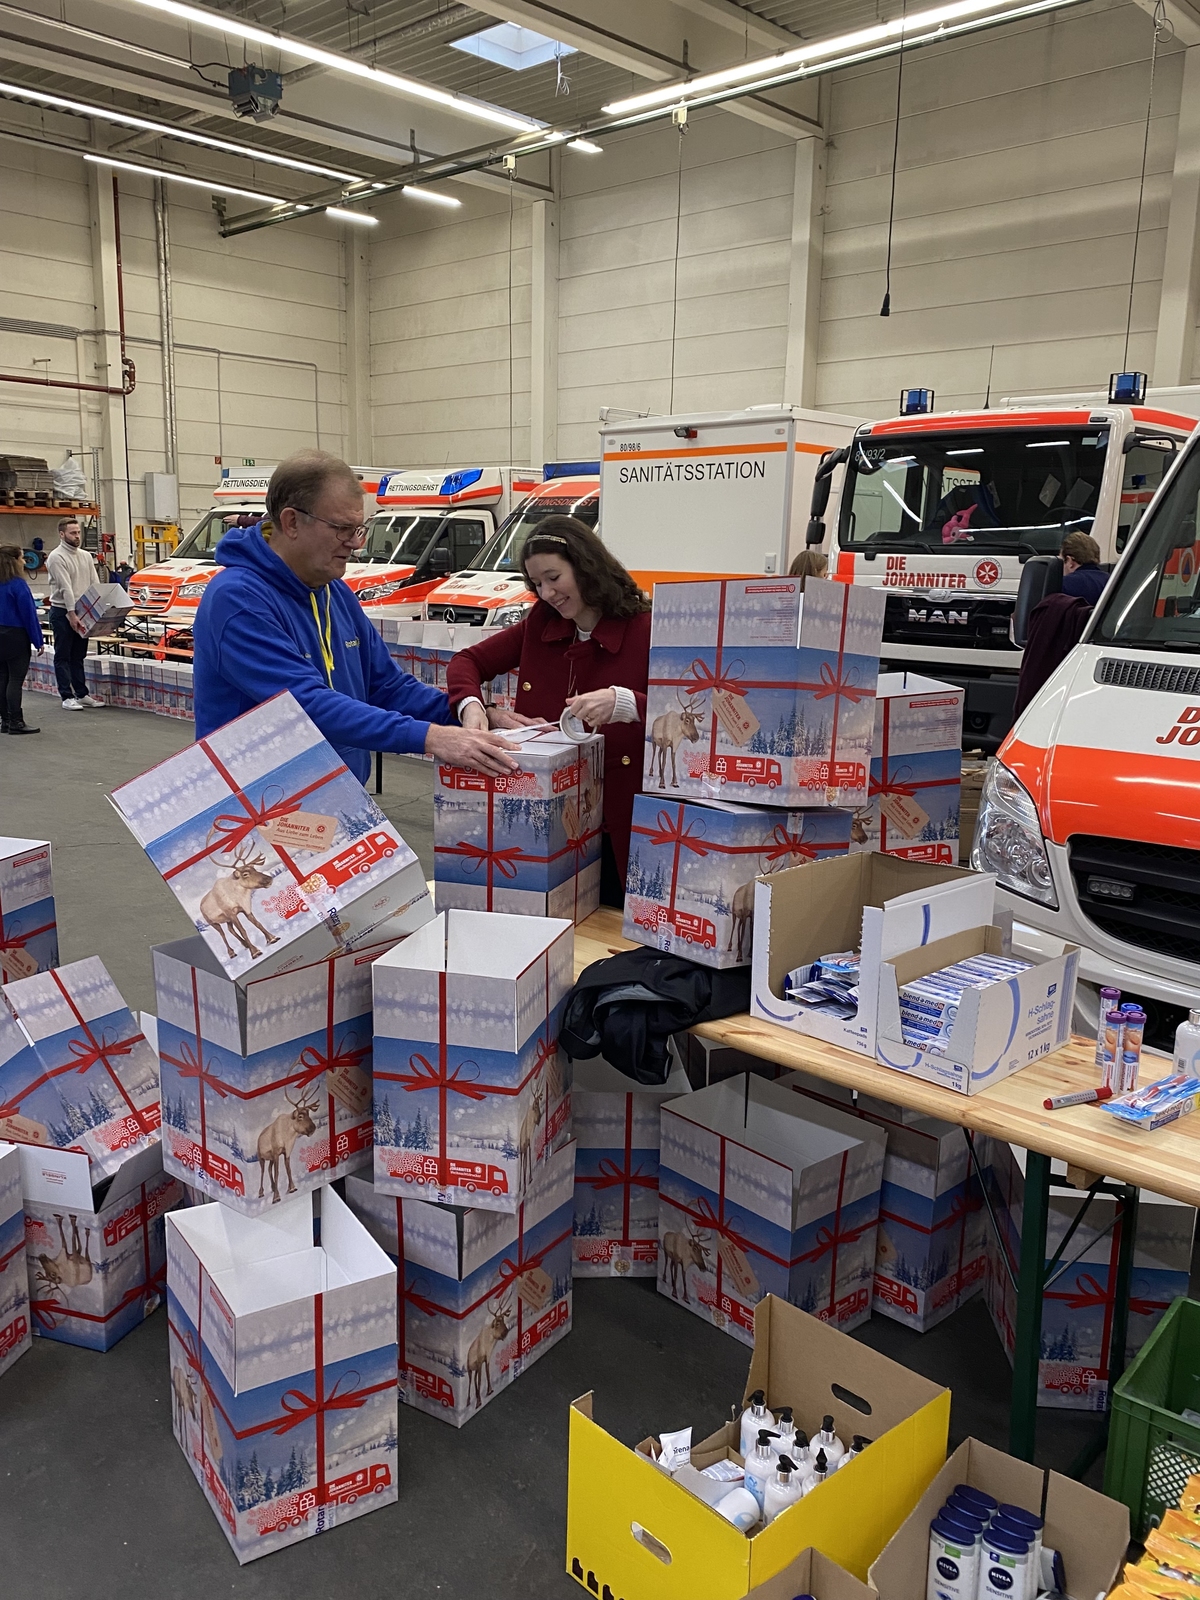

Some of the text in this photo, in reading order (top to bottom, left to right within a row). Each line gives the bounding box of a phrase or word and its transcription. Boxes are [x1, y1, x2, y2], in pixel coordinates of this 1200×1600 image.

[620, 443, 641, 452] 80/98/6
[855, 449, 886, 461] 8/93/2
[620, 462, 765, 483] SANITÄTSSTATION
[388, 484, 439, 492] RETTUNGSDIENST
[886, 556, 906, 570] DIE
[882, 572, 967, 588] JOHANNITER
[908, 609, 968, 625] MAN
[893, 799, 911, 818] JOHANNITER
[277, 822, 310, 831] JOHANNITER
[328, 907, 342, 927] Rotary
[1028, 1001, 1055, 1018] H-Schlag-
[1037, 1010, 1054, 1024] sahne
[1028, 1050, 1033, 1060] 12
[1044, 1042, 1050, 1053] kg
[925, 1063, 962, 1079] H-Schlagsahne
[6, 1124, 28, 1135] JOHANNITER
[939, 1561, 958, 1573] NIVEA
[991, 1572, 1011, 1582] NIVEA
[934, 1578, 960, 1594] SENSITIVE
[986, 1586, 1013, 1600] SENSITIVE
